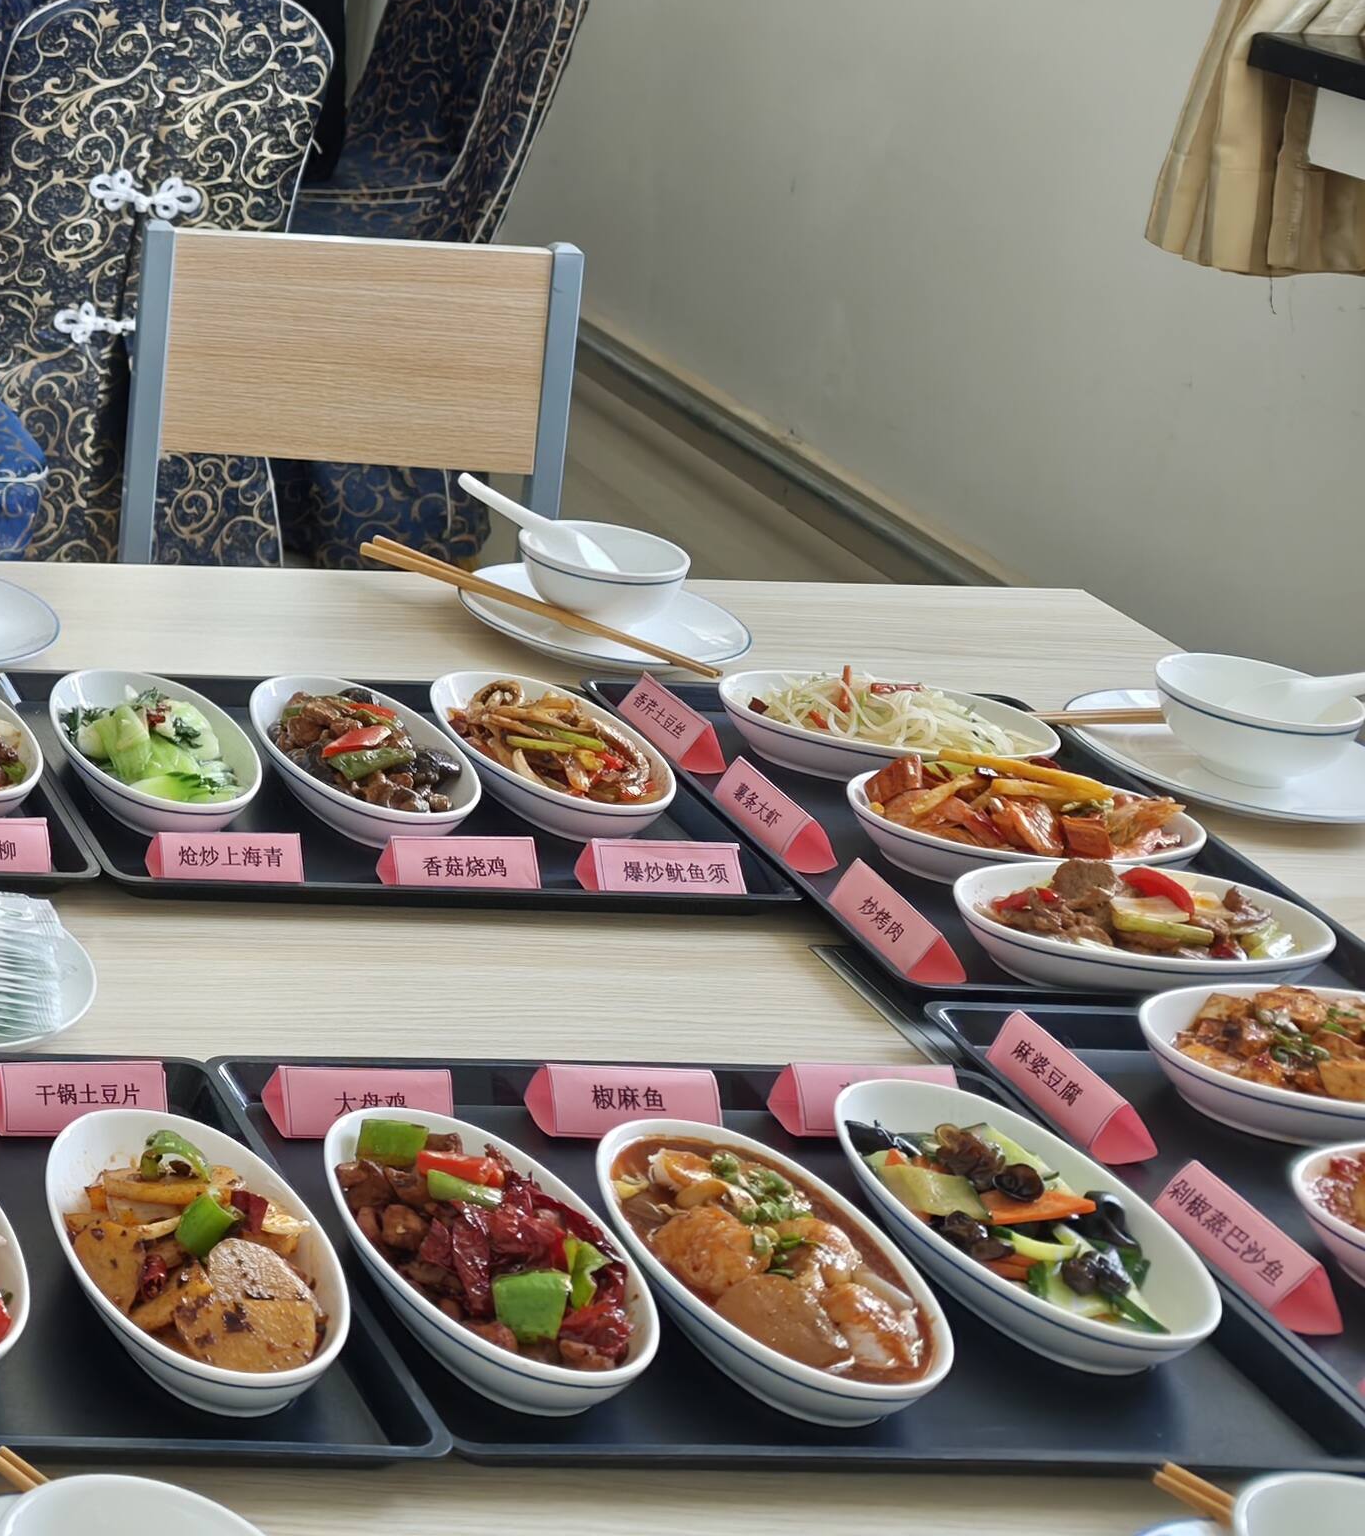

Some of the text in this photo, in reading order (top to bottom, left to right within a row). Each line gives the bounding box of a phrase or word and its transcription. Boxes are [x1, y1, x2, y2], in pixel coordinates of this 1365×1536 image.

[633, 691, 688, 740] 香芹土豆丝
[732, 782, 783, 829] 薯条大虾
[178, 845, 284, 867] 炝炒上海青
[422, 856, 507, 877] 香菇烧鸡
[623, 861, 730, 884] 爆炒鱿鱼须
[857, 895, 905, 943] 炒烤肉
[1010, 1038, 1085, 1108] 麻婆豆腐
[35, 1083, 140, 1106] 干锅土豆片
[591, 1084, 667, 1112] 椒麻鱼
[1167, 1178, 1286, 1288] 剁椒蒸巴沙鱼
